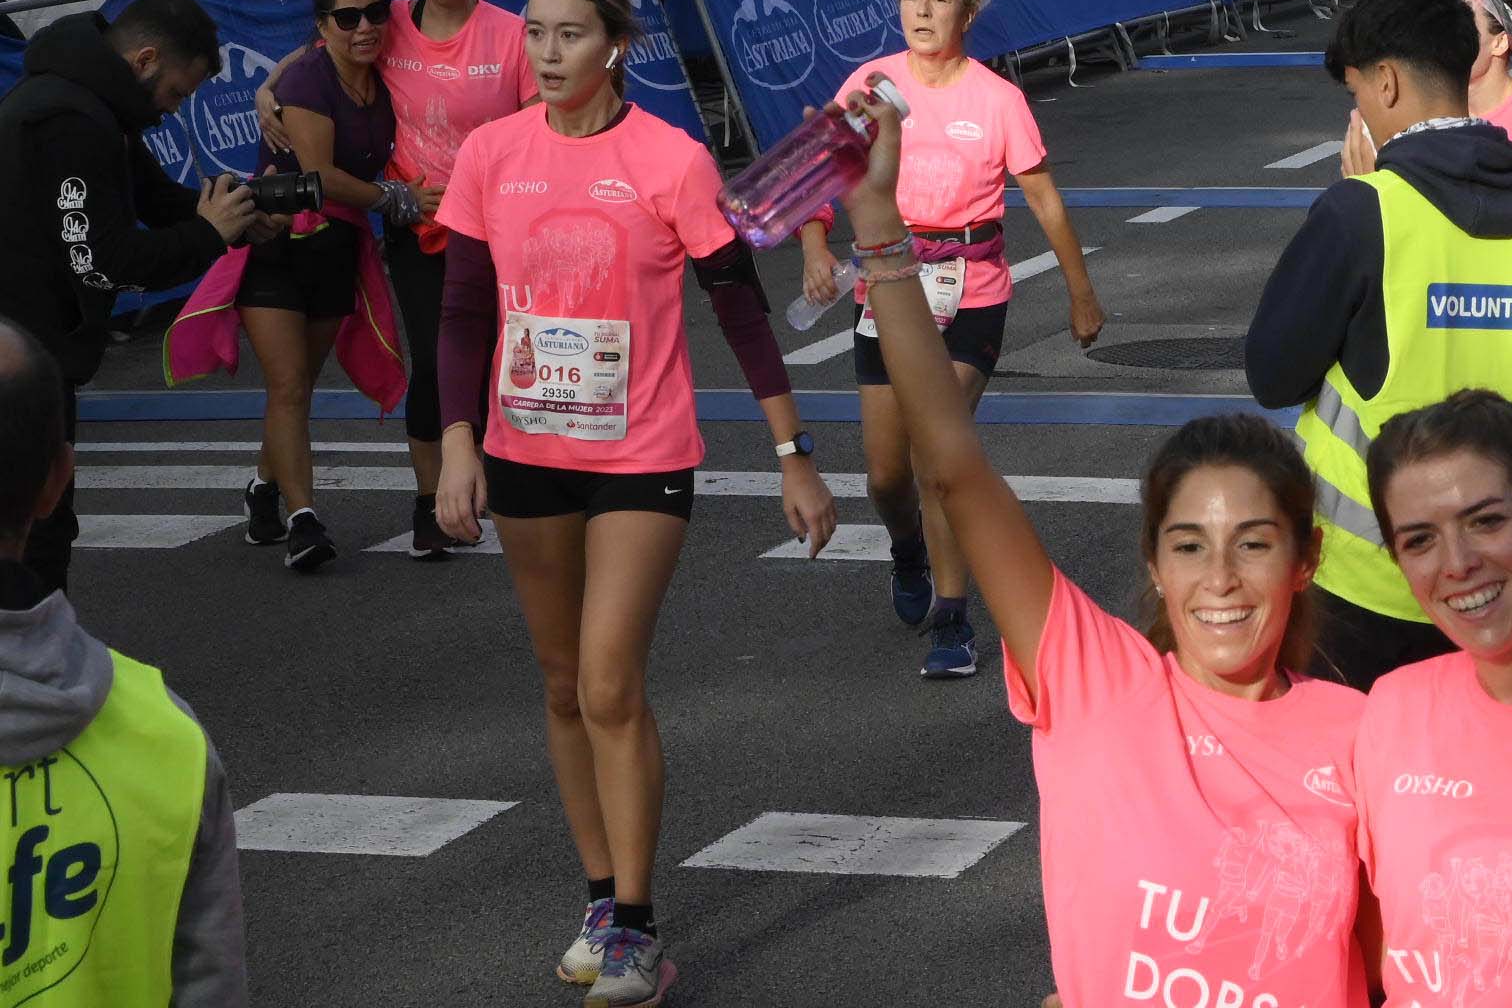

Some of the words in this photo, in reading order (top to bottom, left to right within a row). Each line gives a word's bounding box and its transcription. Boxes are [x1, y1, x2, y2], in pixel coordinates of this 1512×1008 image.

[468, 64, 501, 75] DKV
[500, 180, 547, 195] OYSHO
[592, 188, 637, 201] ASTURIANA
[537, 337, 584, 350] ASTURIANA
[539, 365, 581, 384] 016
[542, 388, 576, 399] 29350
[513, 400, 544, 409] CARRERA
[568, 405, 593, 413] MUJER
[576, 421, 617, 432] Santander
[1394, 774, 1473, 799] OYSHO
[1137, 879, 1209, 942] TU
[23, 941, 69, 979] deporte
